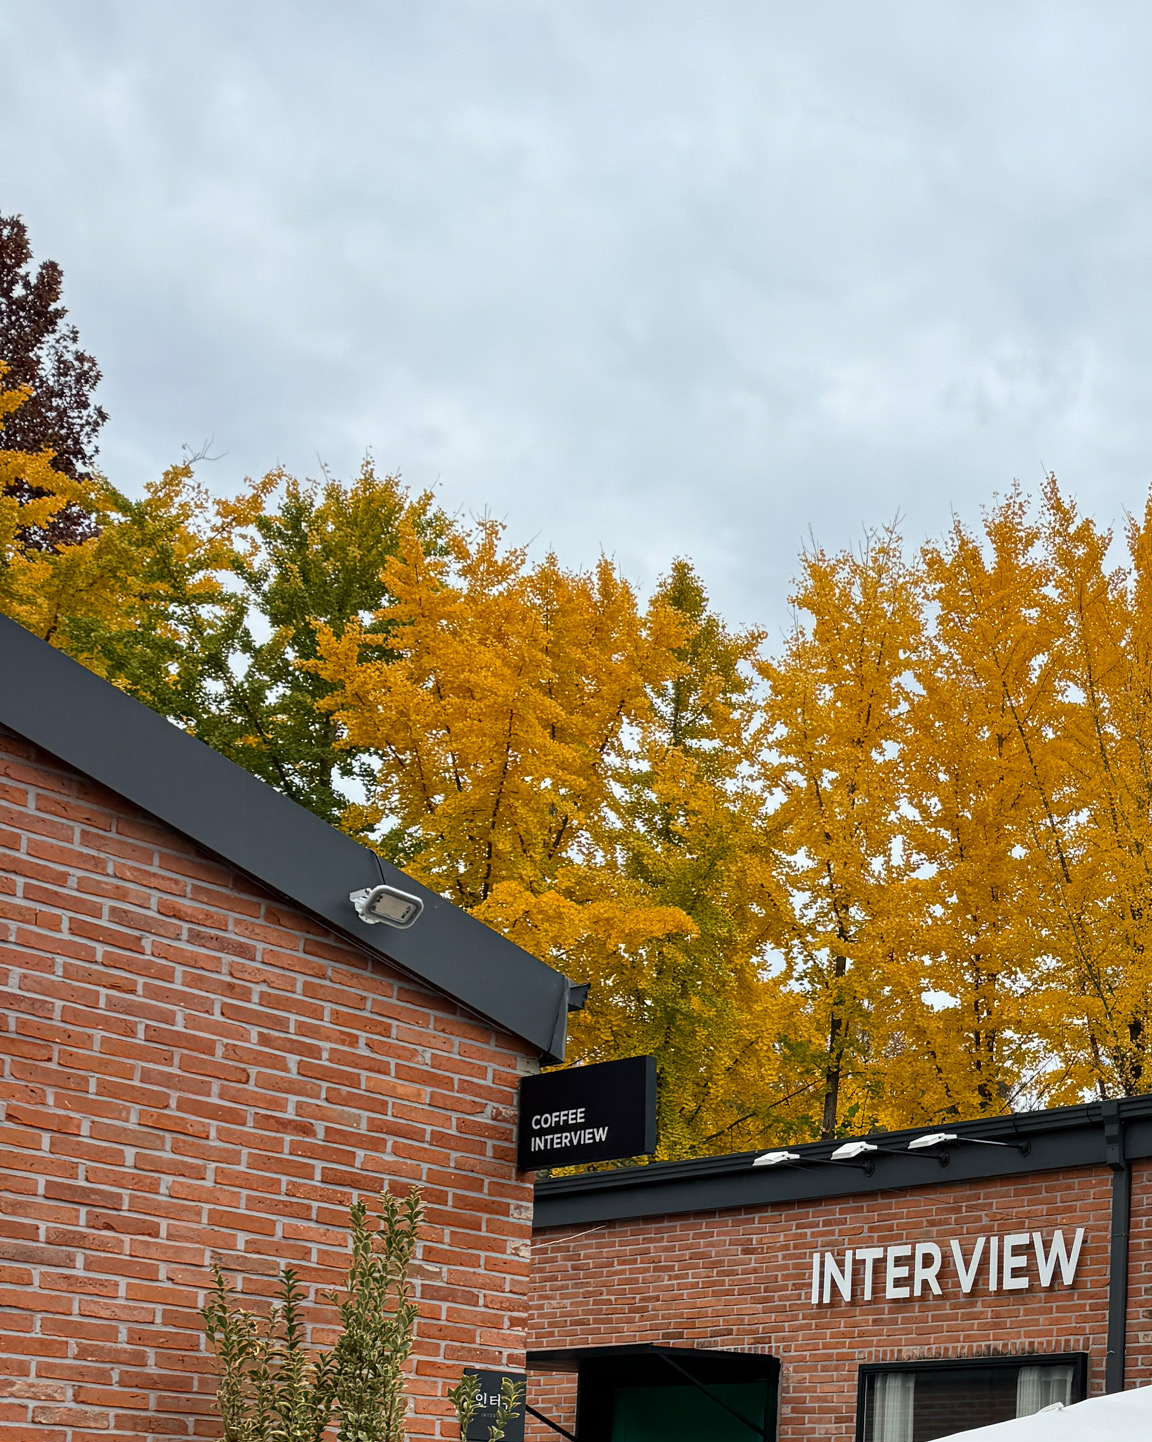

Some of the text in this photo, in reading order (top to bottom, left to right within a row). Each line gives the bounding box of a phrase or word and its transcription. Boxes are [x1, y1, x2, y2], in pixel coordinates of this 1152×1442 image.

[531, 1108, 586, 1130] COFFEE
[530, 1126, 608, 1152] INTERVIEW
[811, 1228, 1085, 1304] INTERVIEW
[475, 1393, 508, 1410] 인터
